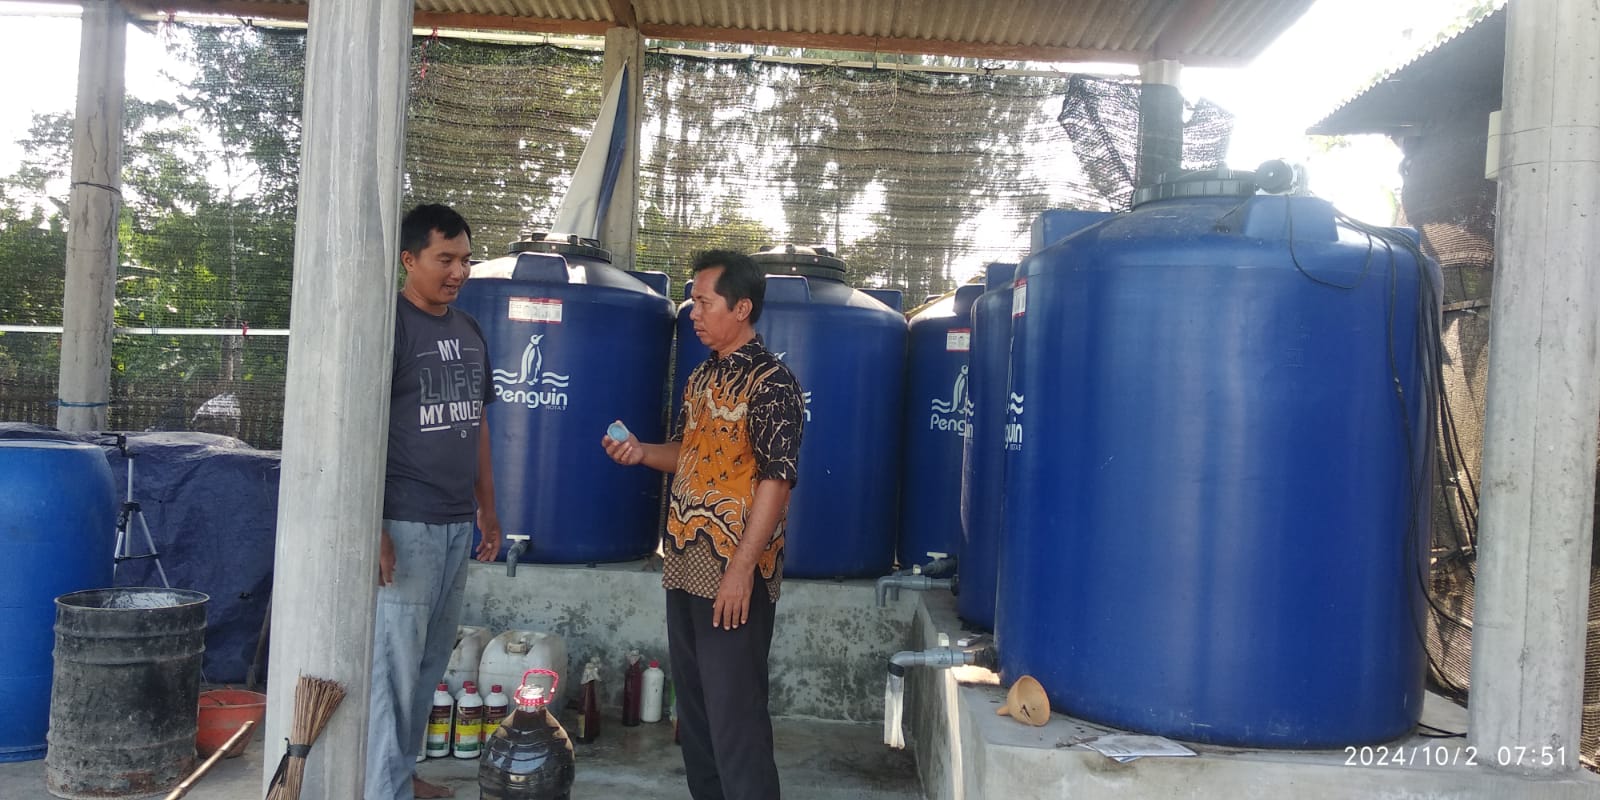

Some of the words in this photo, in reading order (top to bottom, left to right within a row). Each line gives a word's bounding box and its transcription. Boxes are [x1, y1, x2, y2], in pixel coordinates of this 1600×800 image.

[437, 339, 461, 361] MY
[420, 363, 482, 403] LIFE
[420, 403, 444, 426] MY
[930, 413, 967, 437] Peng
